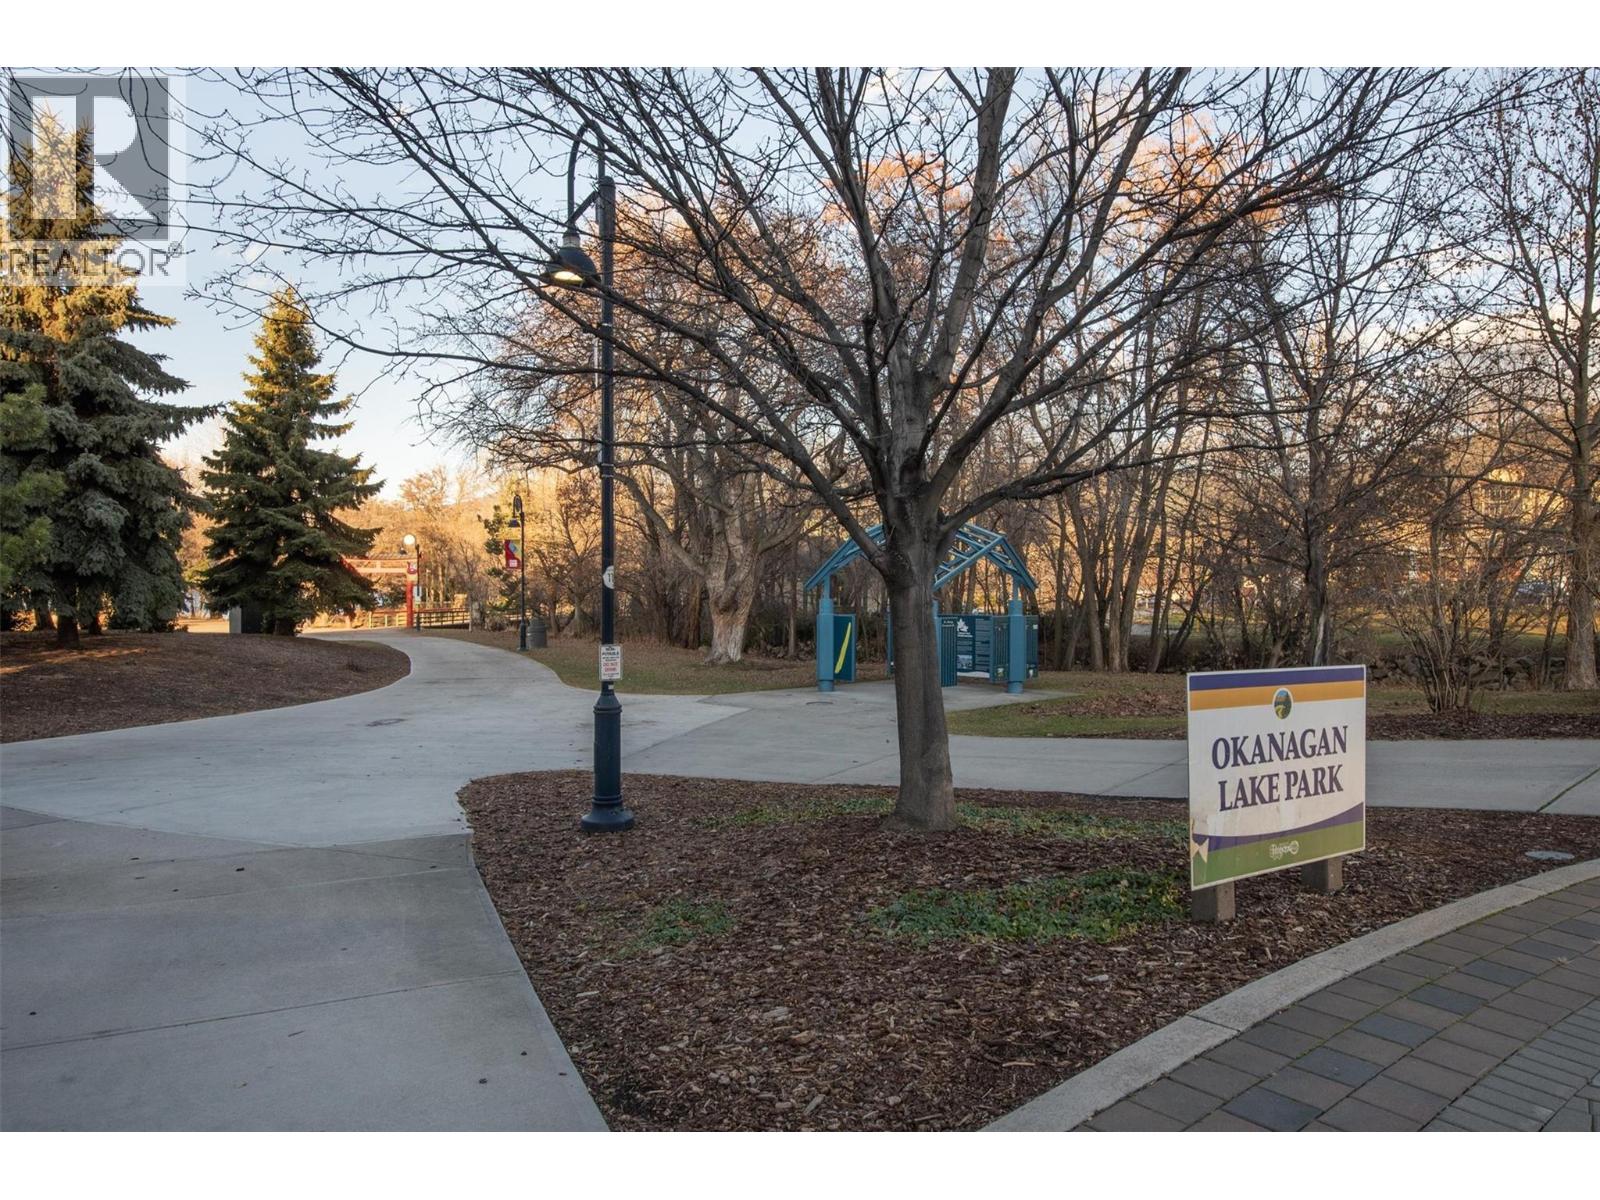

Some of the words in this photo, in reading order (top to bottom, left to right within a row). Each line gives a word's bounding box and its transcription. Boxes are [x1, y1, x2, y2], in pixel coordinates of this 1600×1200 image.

[1211, 725, 1348, 769] OKANAGAN
[1218, 773, 1280, 812] LAKE
[1284, 764, 1344, 801] PARK
